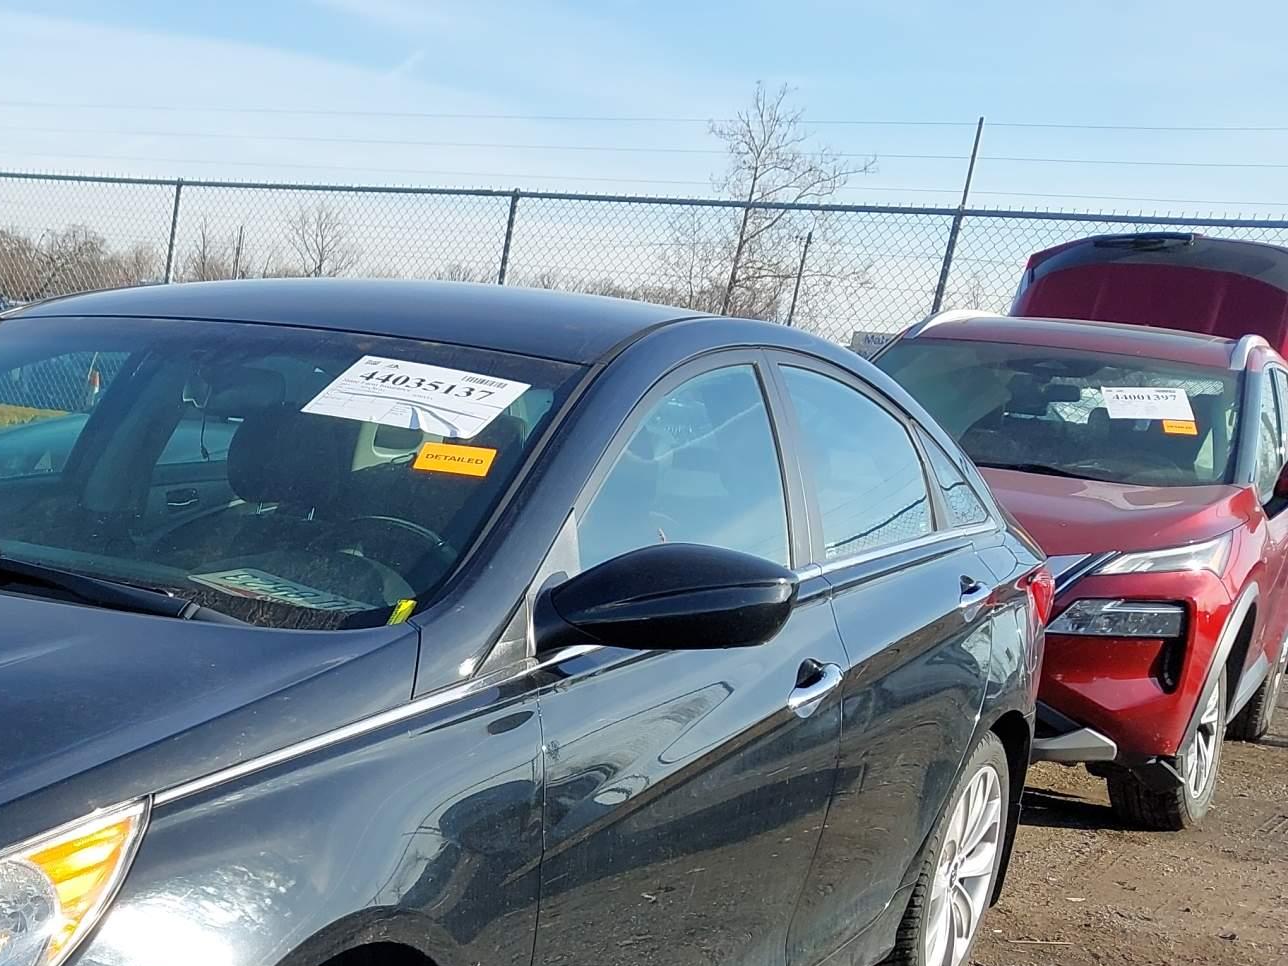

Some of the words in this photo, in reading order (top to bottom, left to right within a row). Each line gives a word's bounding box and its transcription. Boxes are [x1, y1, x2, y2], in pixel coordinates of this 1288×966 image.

[359, 370, 495, 401] 44035137
[1113, 393, 1177, 401] 44001397
[425, 453, 484, 465] DETAILED
